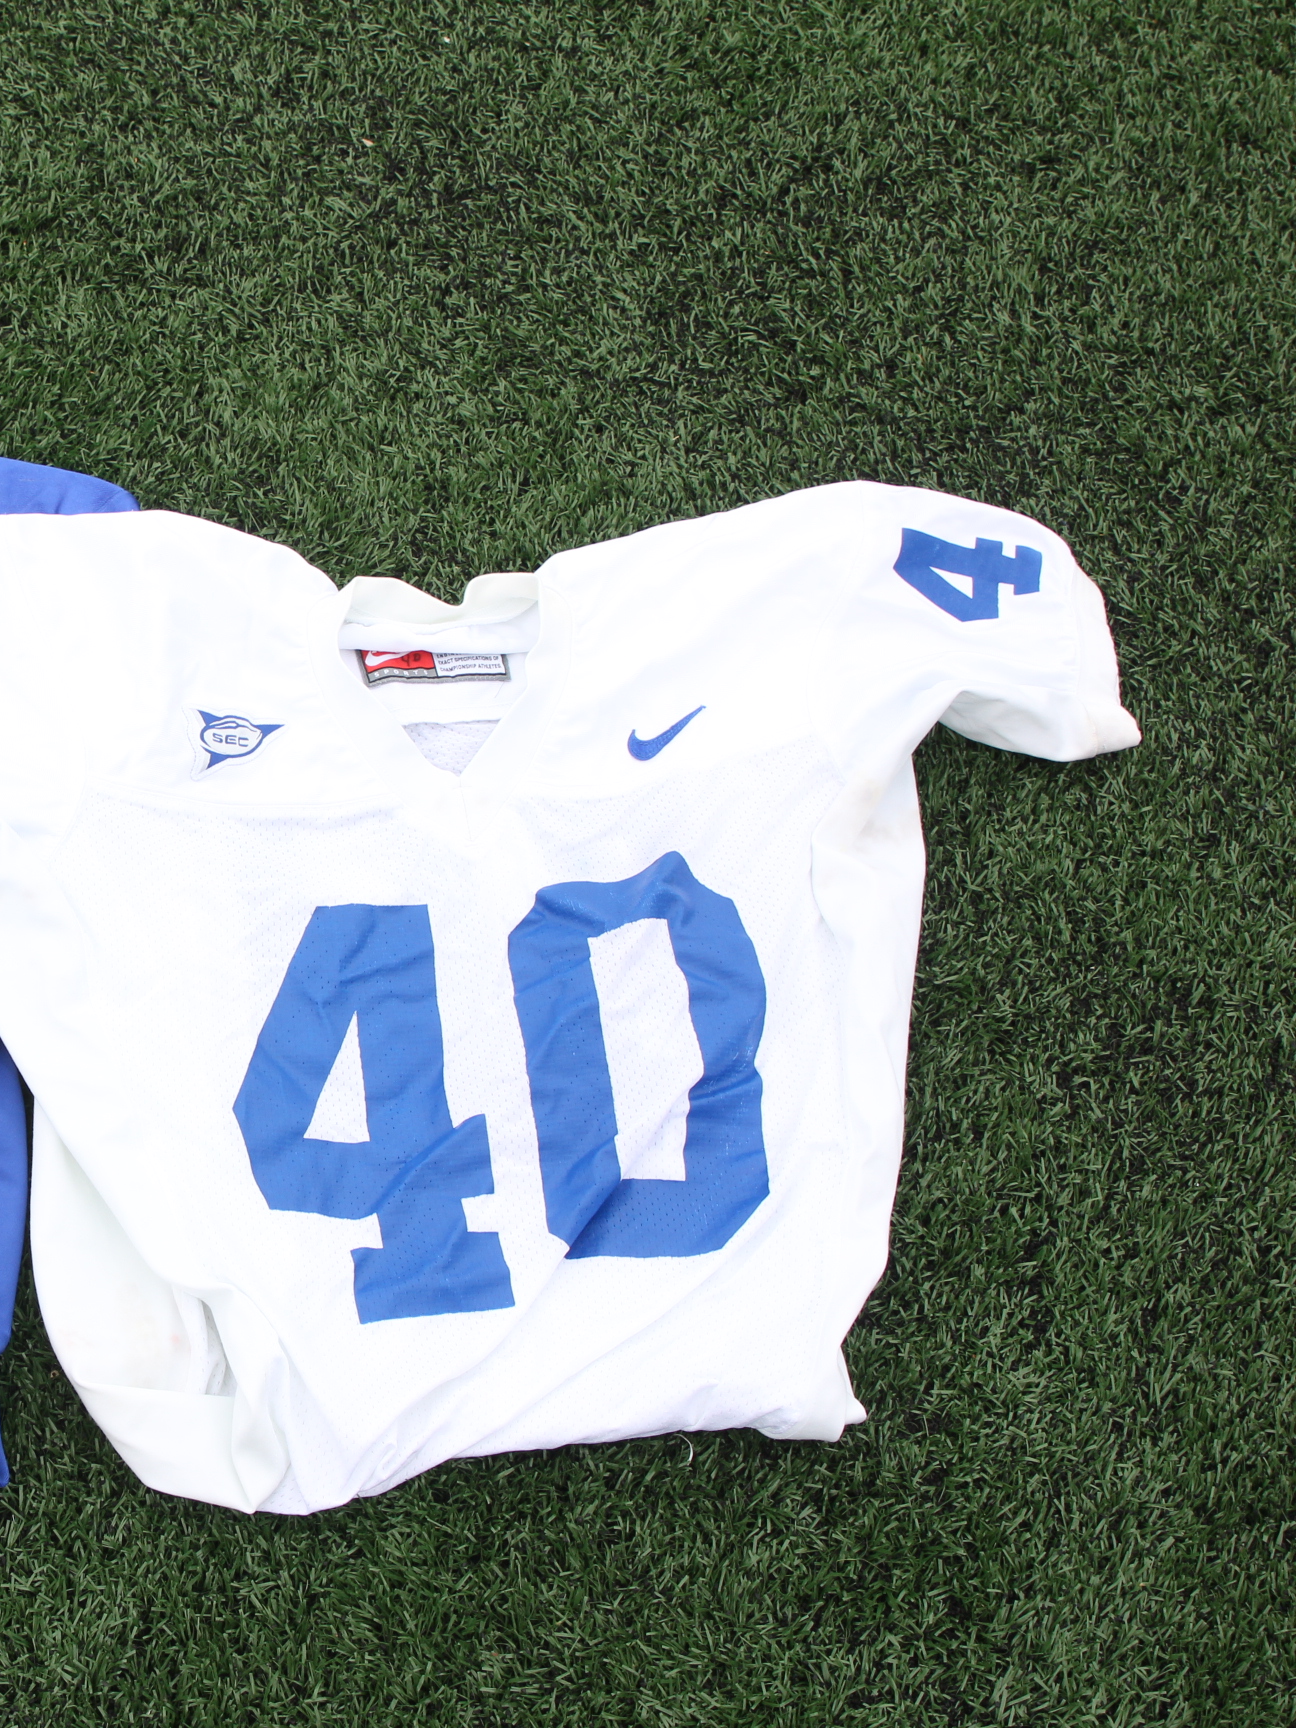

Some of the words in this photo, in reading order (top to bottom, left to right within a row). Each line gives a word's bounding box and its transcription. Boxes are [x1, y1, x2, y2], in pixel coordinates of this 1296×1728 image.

[893, 527, 1043, 623] 4
[374, 668, 428, 677] SPORTS
[440, 663, 477, 672] CHAMPIONSHIP
[212, 732, 250, 748] SEC
[232, 851, 770, 1325] 40
